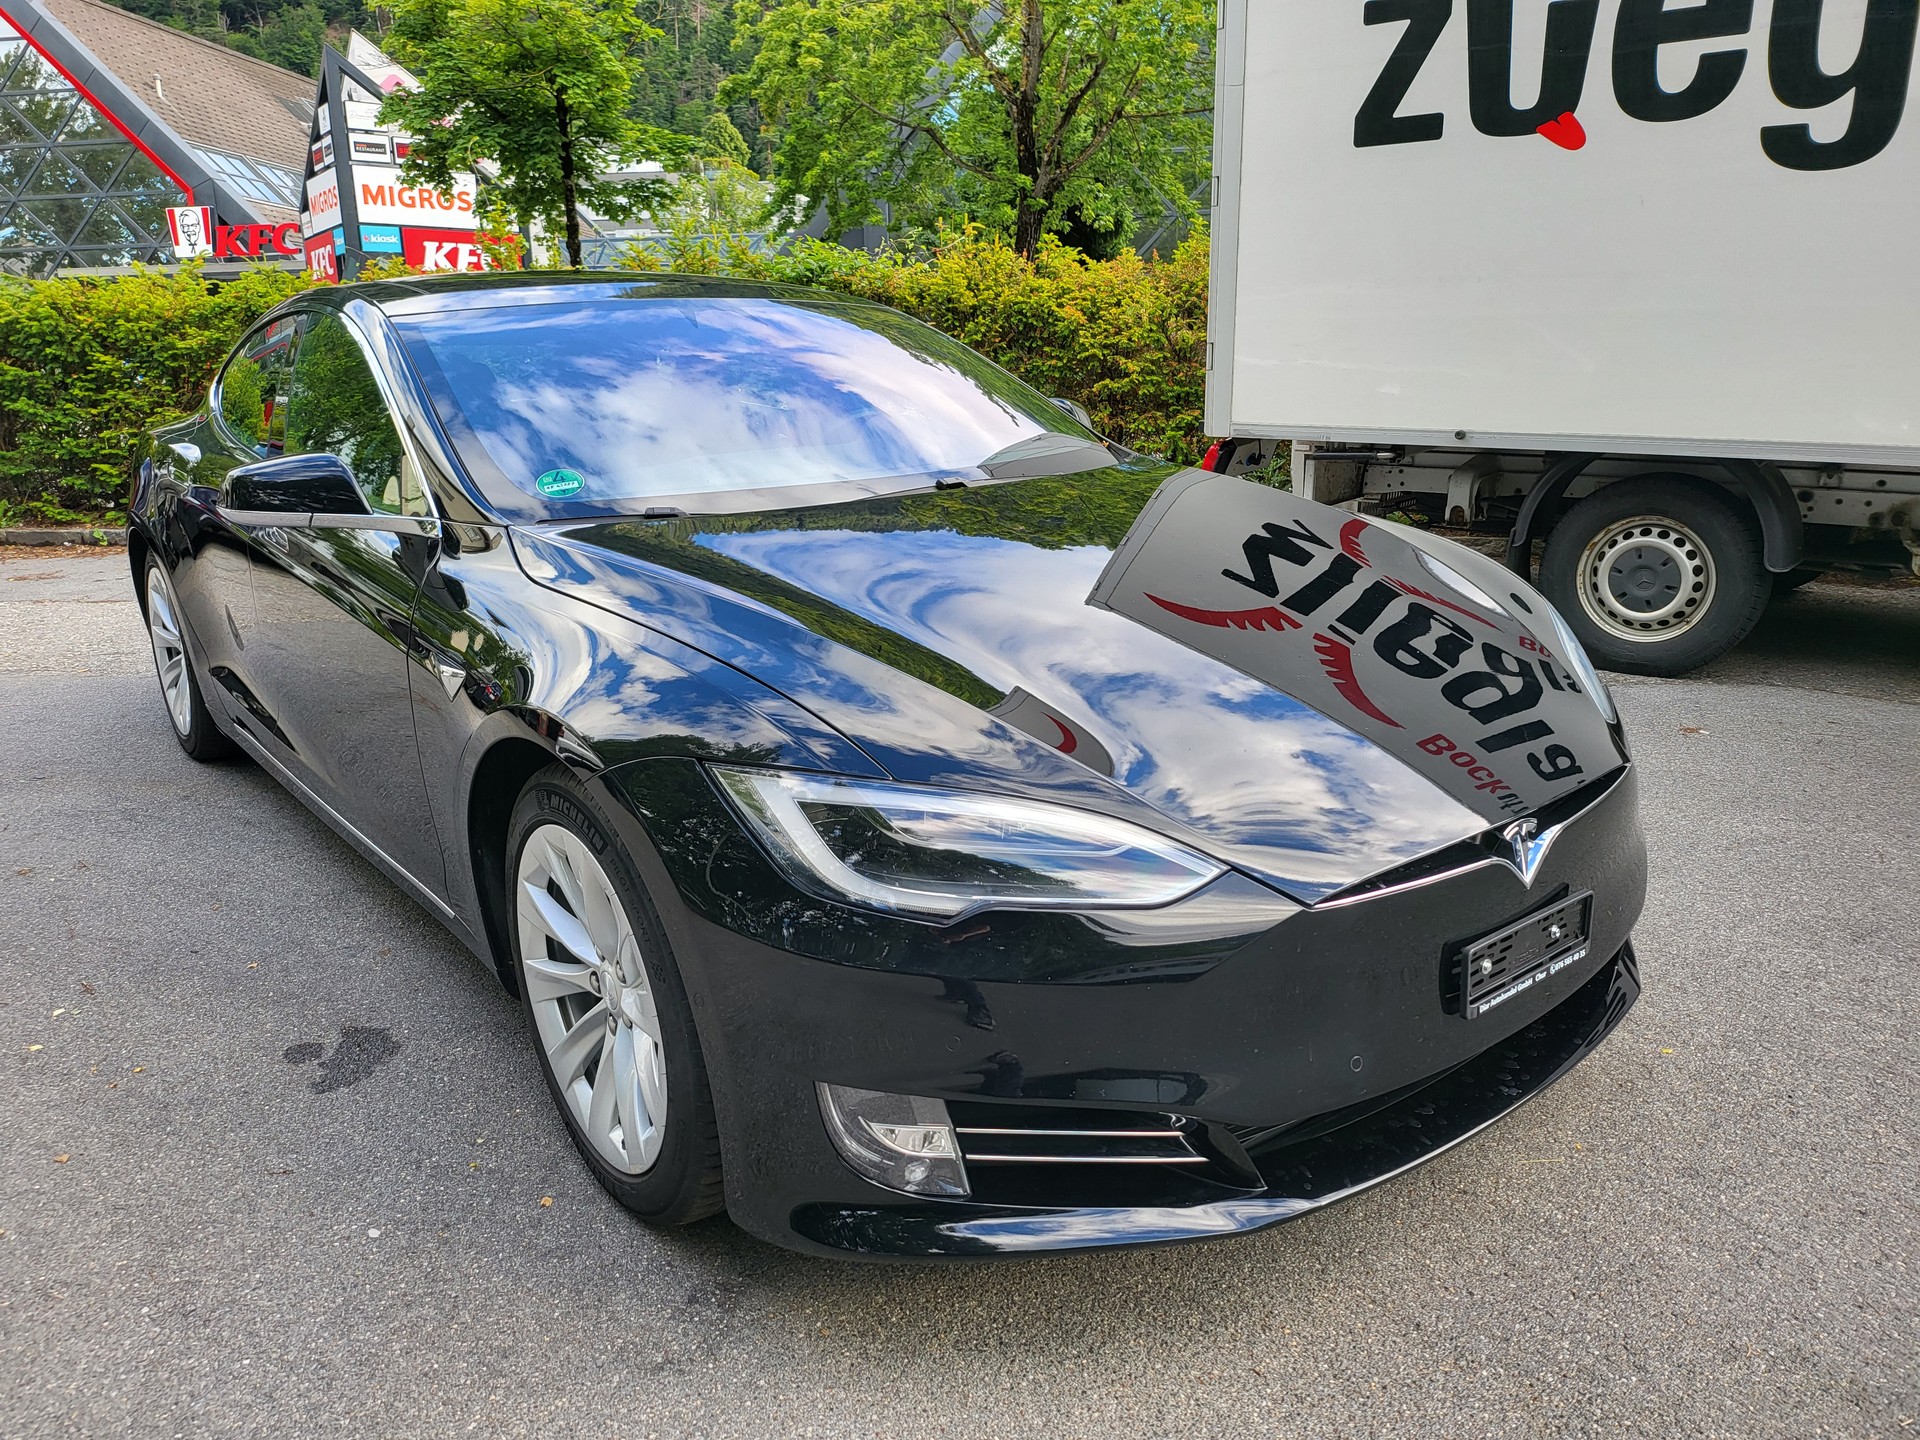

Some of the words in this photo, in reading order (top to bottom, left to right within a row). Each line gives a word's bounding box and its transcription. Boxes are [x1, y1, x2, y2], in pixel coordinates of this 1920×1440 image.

[310, 185, 339, 216] MIGROS
[362, 184, 473, 212] MIGROS
[214, 222, 302, 257] KFC
[370, 234, 399, 244] kiosk
[310, 244, 335, 280] KFC
[549, 793, 604, 850] MICHELIN
[610, 857, 631, 894] PILOT
[1517, 977, 1533, 992] GmbH
